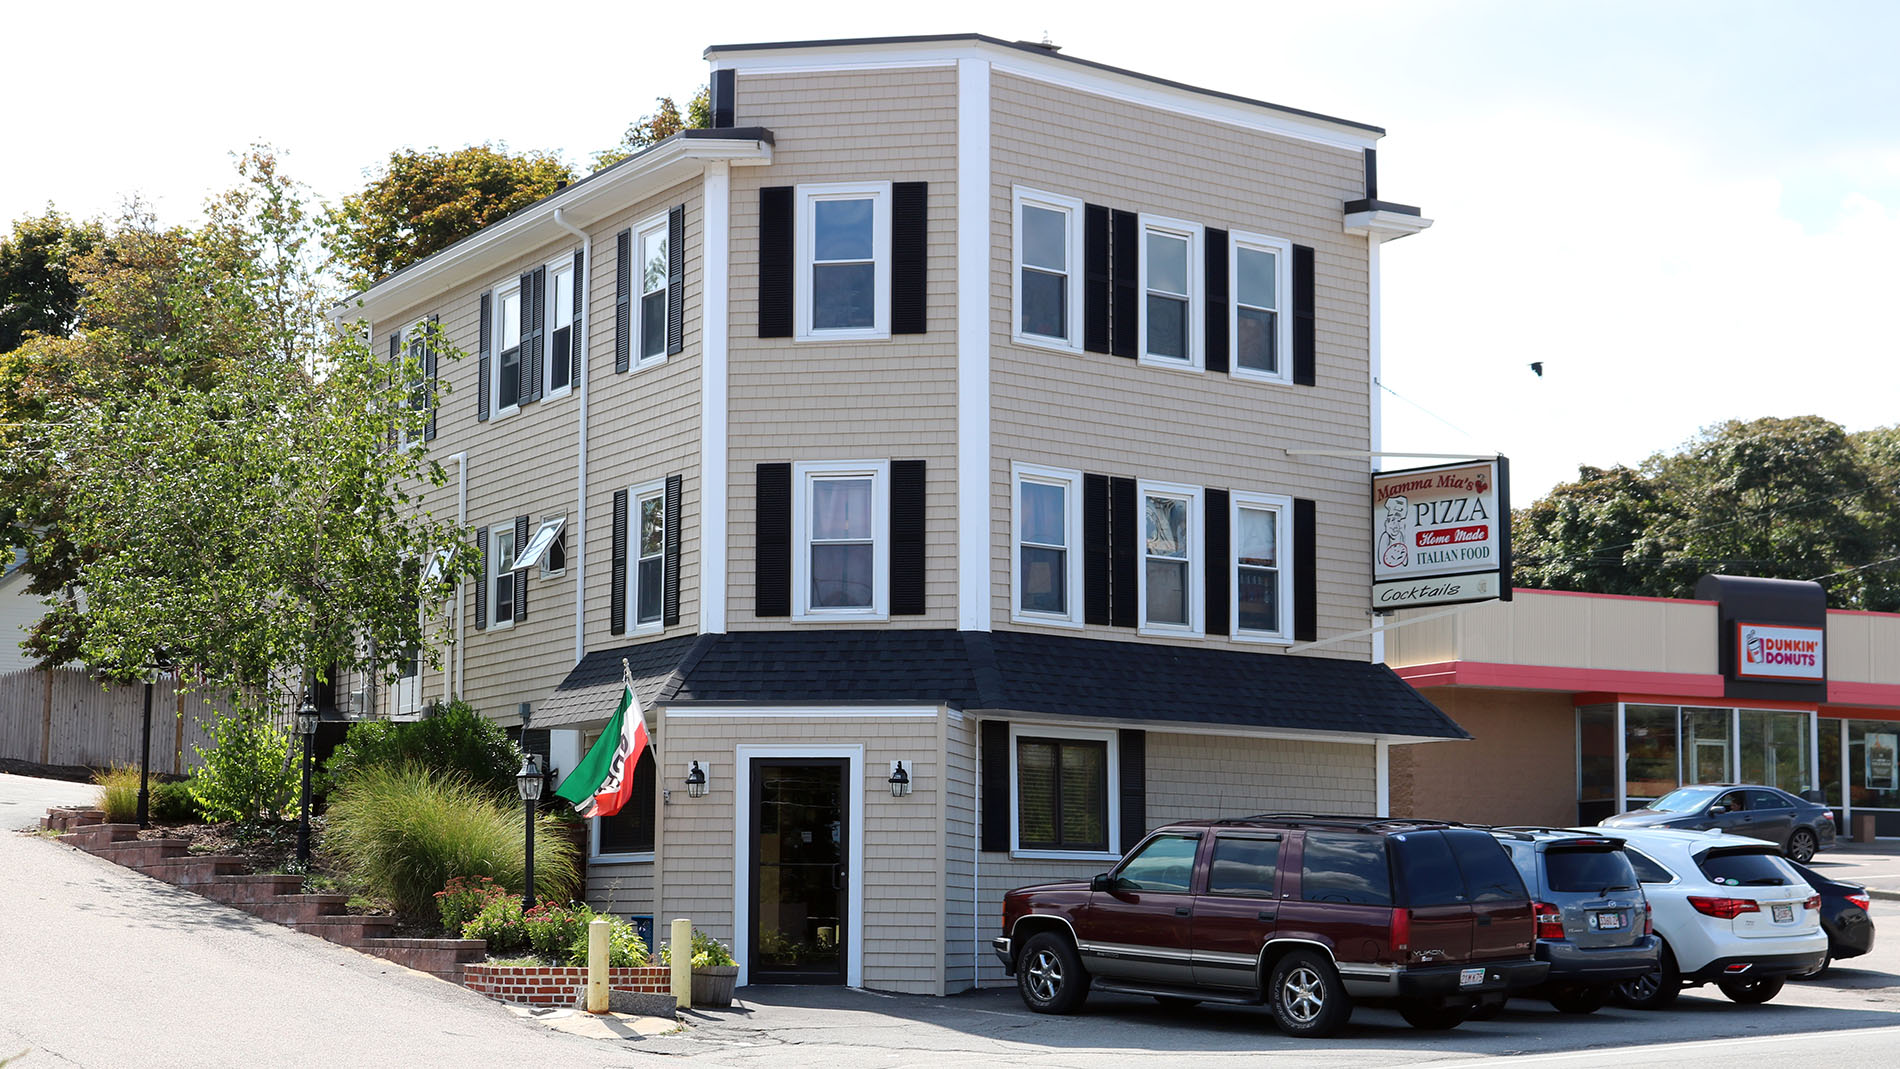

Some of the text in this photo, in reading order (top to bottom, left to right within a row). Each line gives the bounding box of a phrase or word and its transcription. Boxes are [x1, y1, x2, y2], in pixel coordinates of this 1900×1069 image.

[1377, 474, 1474, 502] Mamma Mia's
[1413, 497, 1490, 527] PIZZA
[1419, 528, 1485, 546] Home Made
[1417, 546, 1490, 565] ITALIAN FOOD
[1380, 583, 1462, 602] Cocktails
[1766, 638, 1819, 653] DUNKIN'
[1766, 652, 1815, 666] DONUTS
